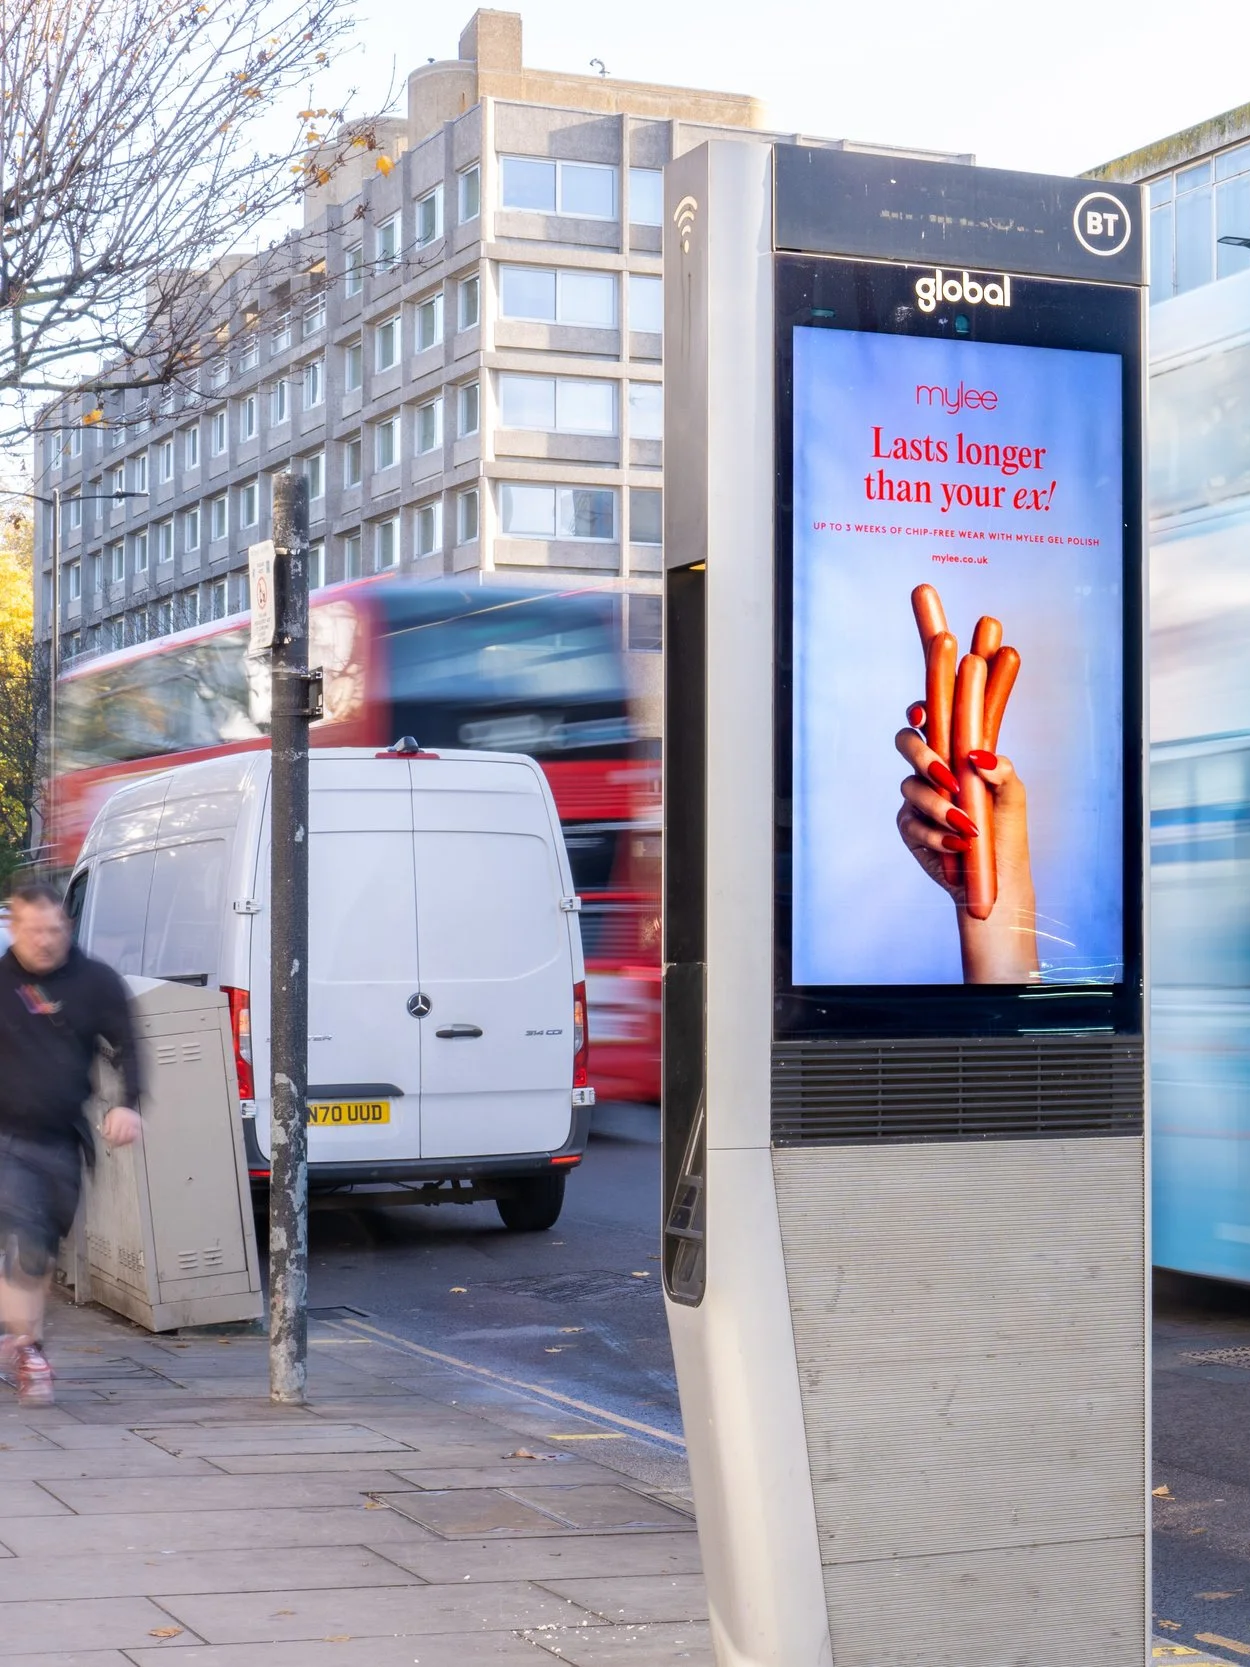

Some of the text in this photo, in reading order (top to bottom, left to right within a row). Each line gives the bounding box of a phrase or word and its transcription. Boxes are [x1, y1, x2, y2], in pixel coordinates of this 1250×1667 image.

[1086, 211, 1119, 237] BT
[915, 268, 1011, 313] global
[916, 380, 998, 415] mylee
[870, 425, 1047, 476] Lasts longer
[863, 468, 1057, 513] than your ex!
[813, 521, 1100, 547] UP TO 3 WEEKS OF CHIP-FREE WEAR WITH MYLEE GEL POLISH
[931, 553, 988, 565] mylee.co.uk
[306, 1104, 383, 1124] N70 UUD
